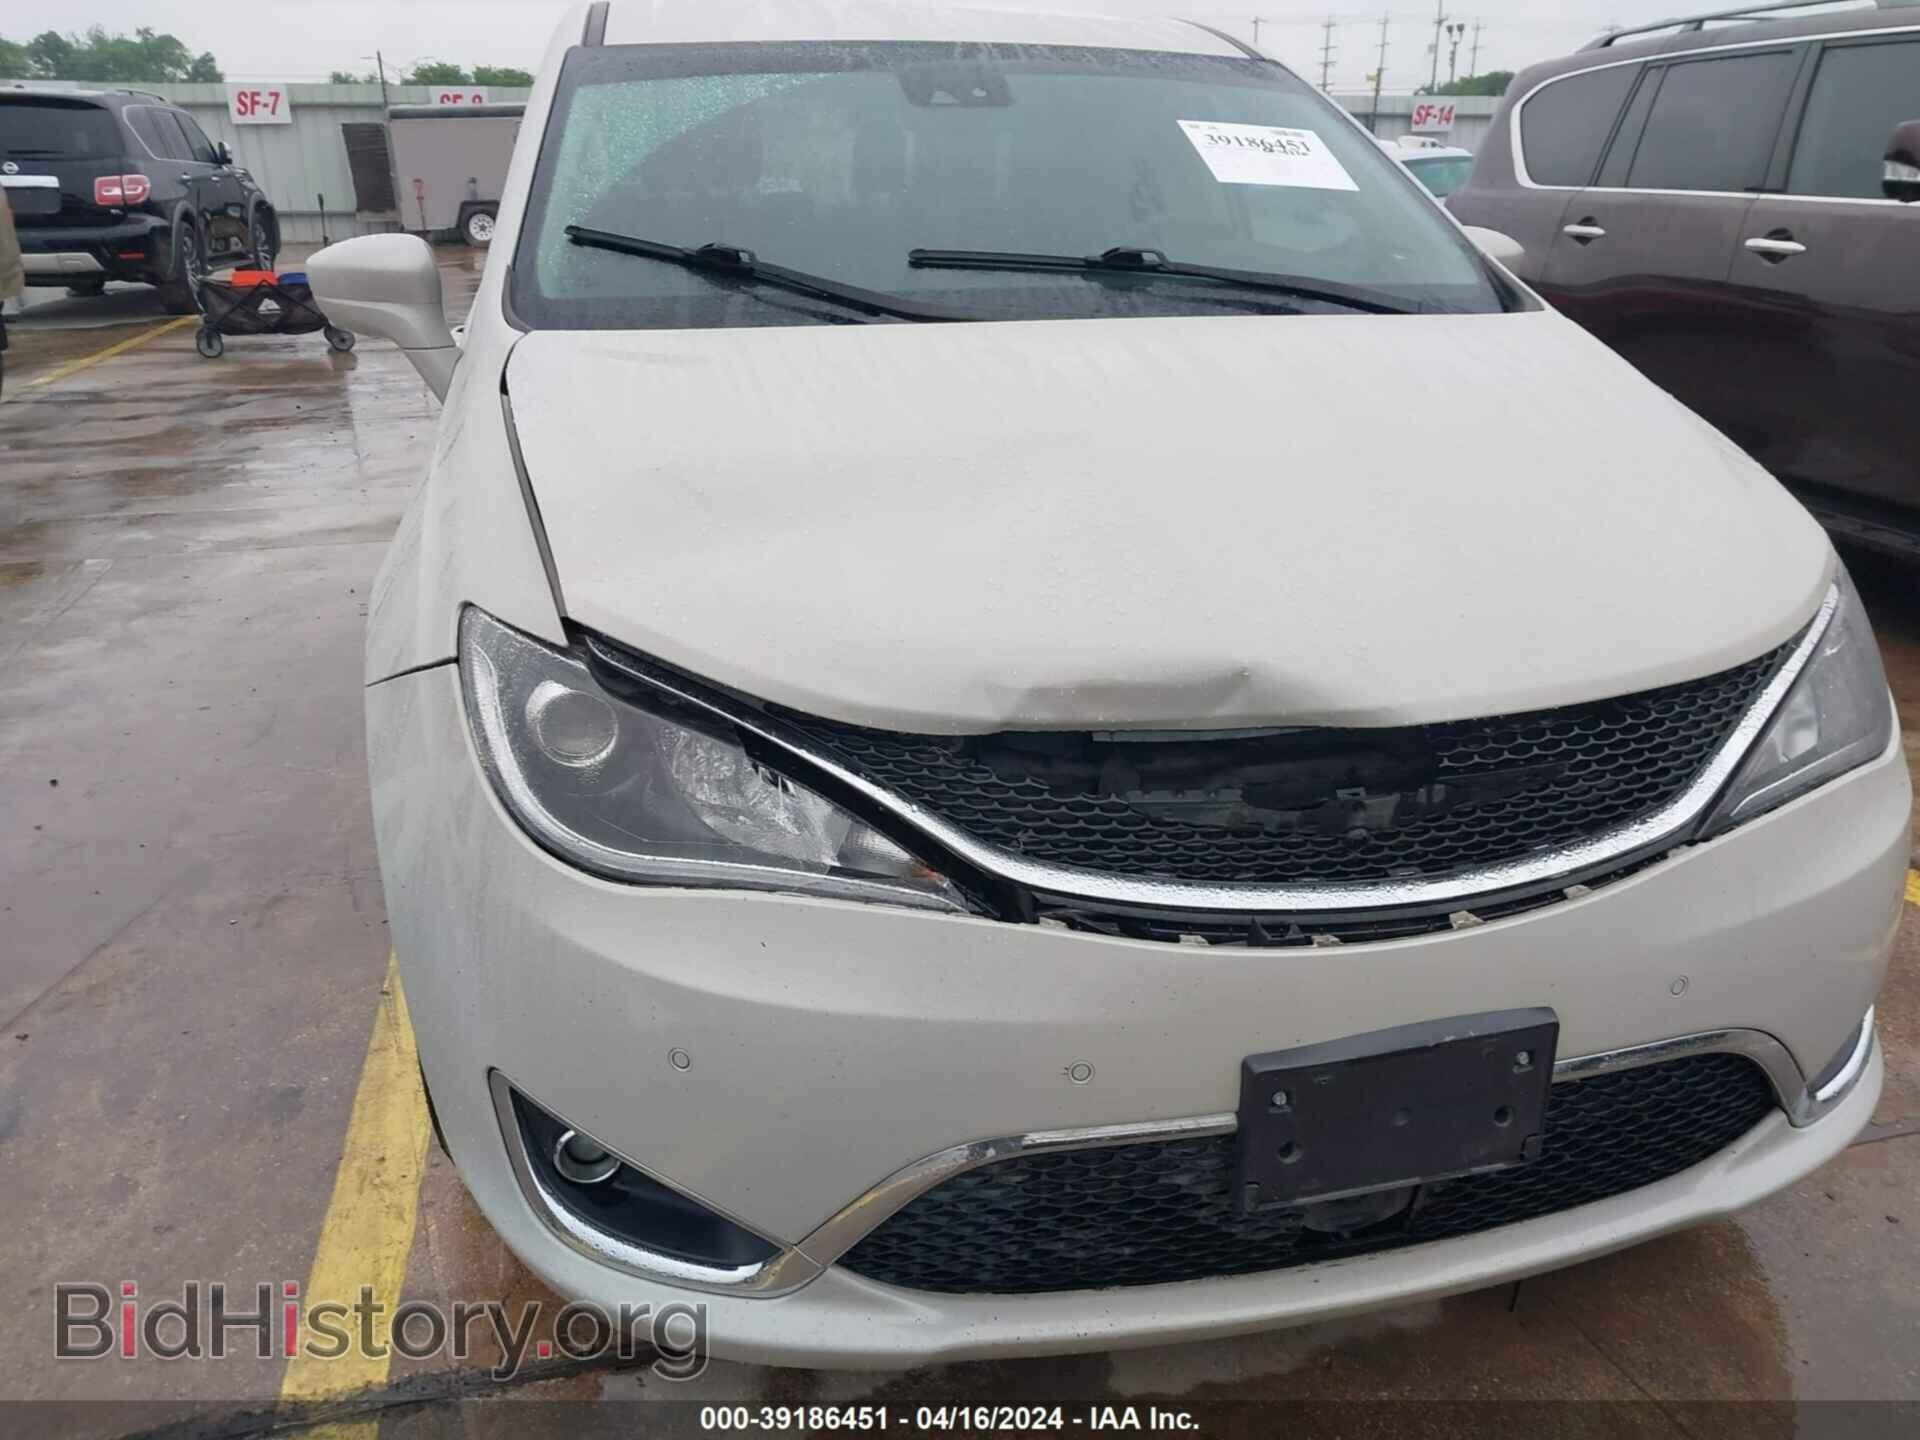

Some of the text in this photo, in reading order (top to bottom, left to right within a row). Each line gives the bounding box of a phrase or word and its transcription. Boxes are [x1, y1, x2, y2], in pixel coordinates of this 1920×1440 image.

[237, 91, 280, 115] SF-7
[1414, 105, 1454, 125] SF-14
[1204, 133, 1311, 152] 39186451
